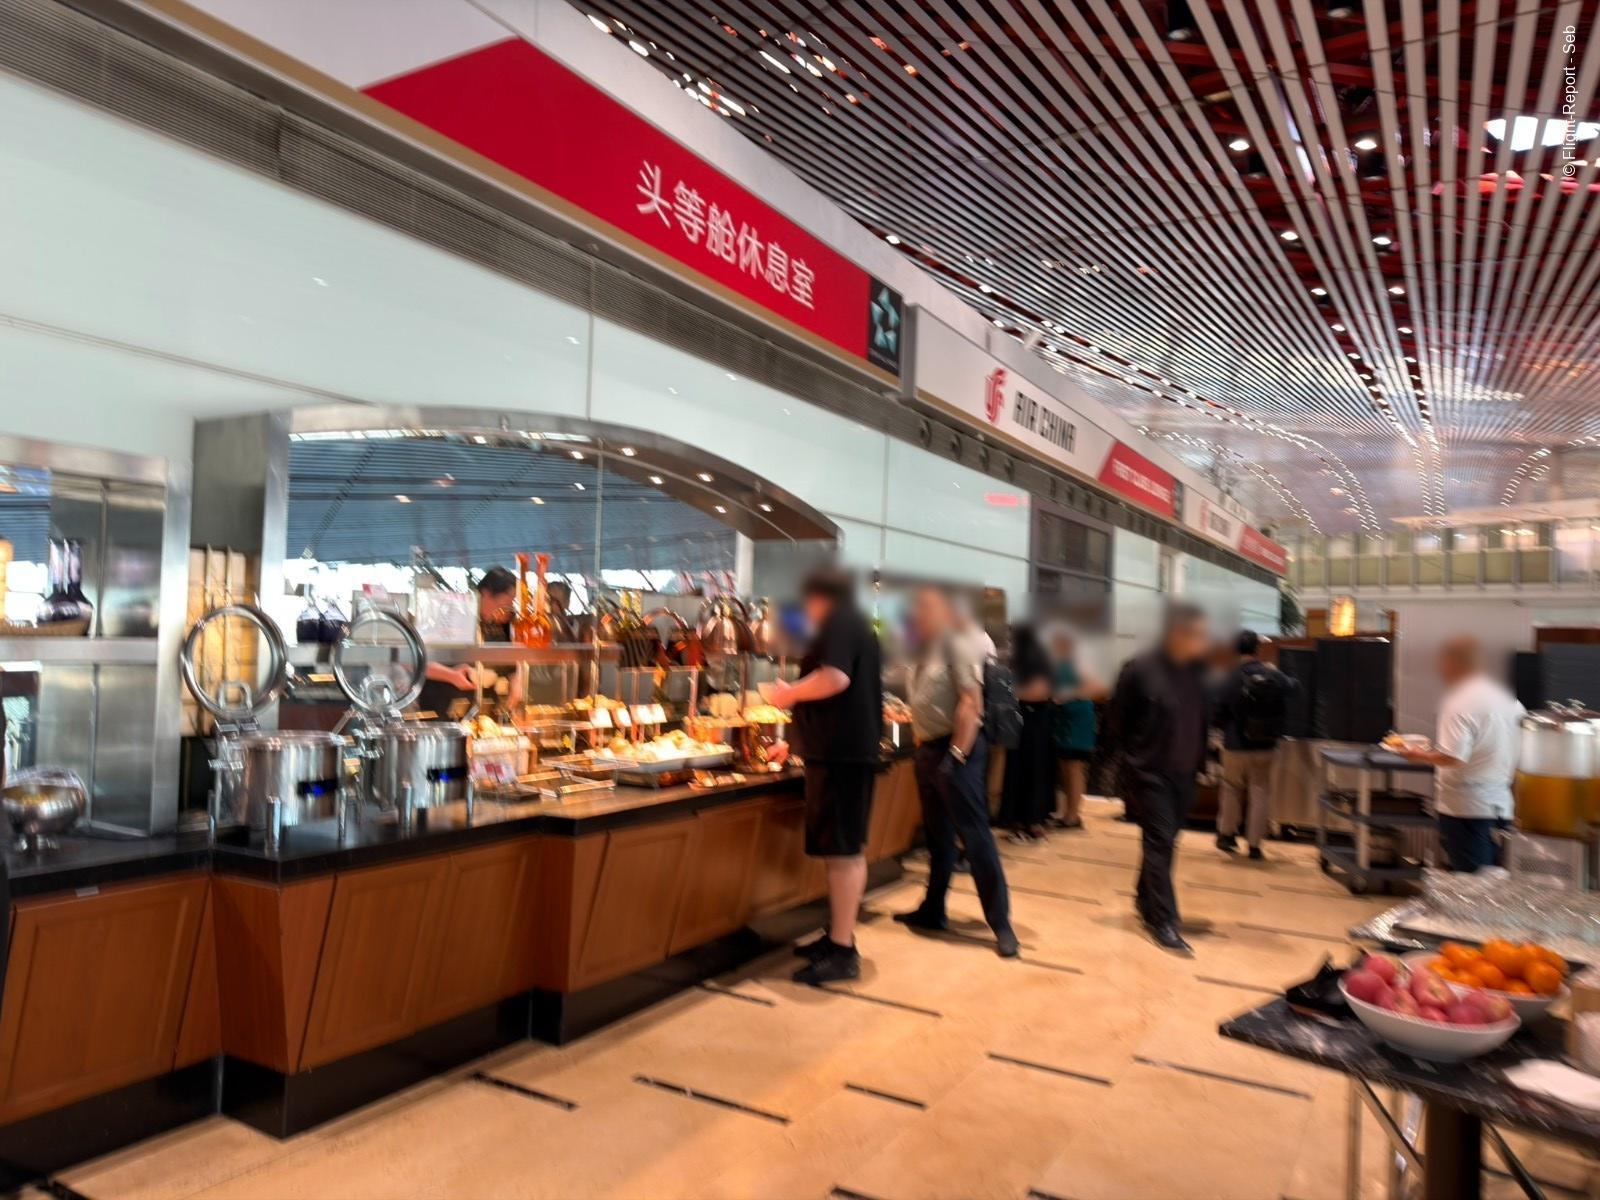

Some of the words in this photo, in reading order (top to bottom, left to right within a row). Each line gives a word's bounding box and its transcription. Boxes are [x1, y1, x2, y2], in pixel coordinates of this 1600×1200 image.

[636, 159, 815, 310] 头等舱休息室
[1013, 391, 1037, 432] AIR
[1039, 407, 1076, 453] CHINA
